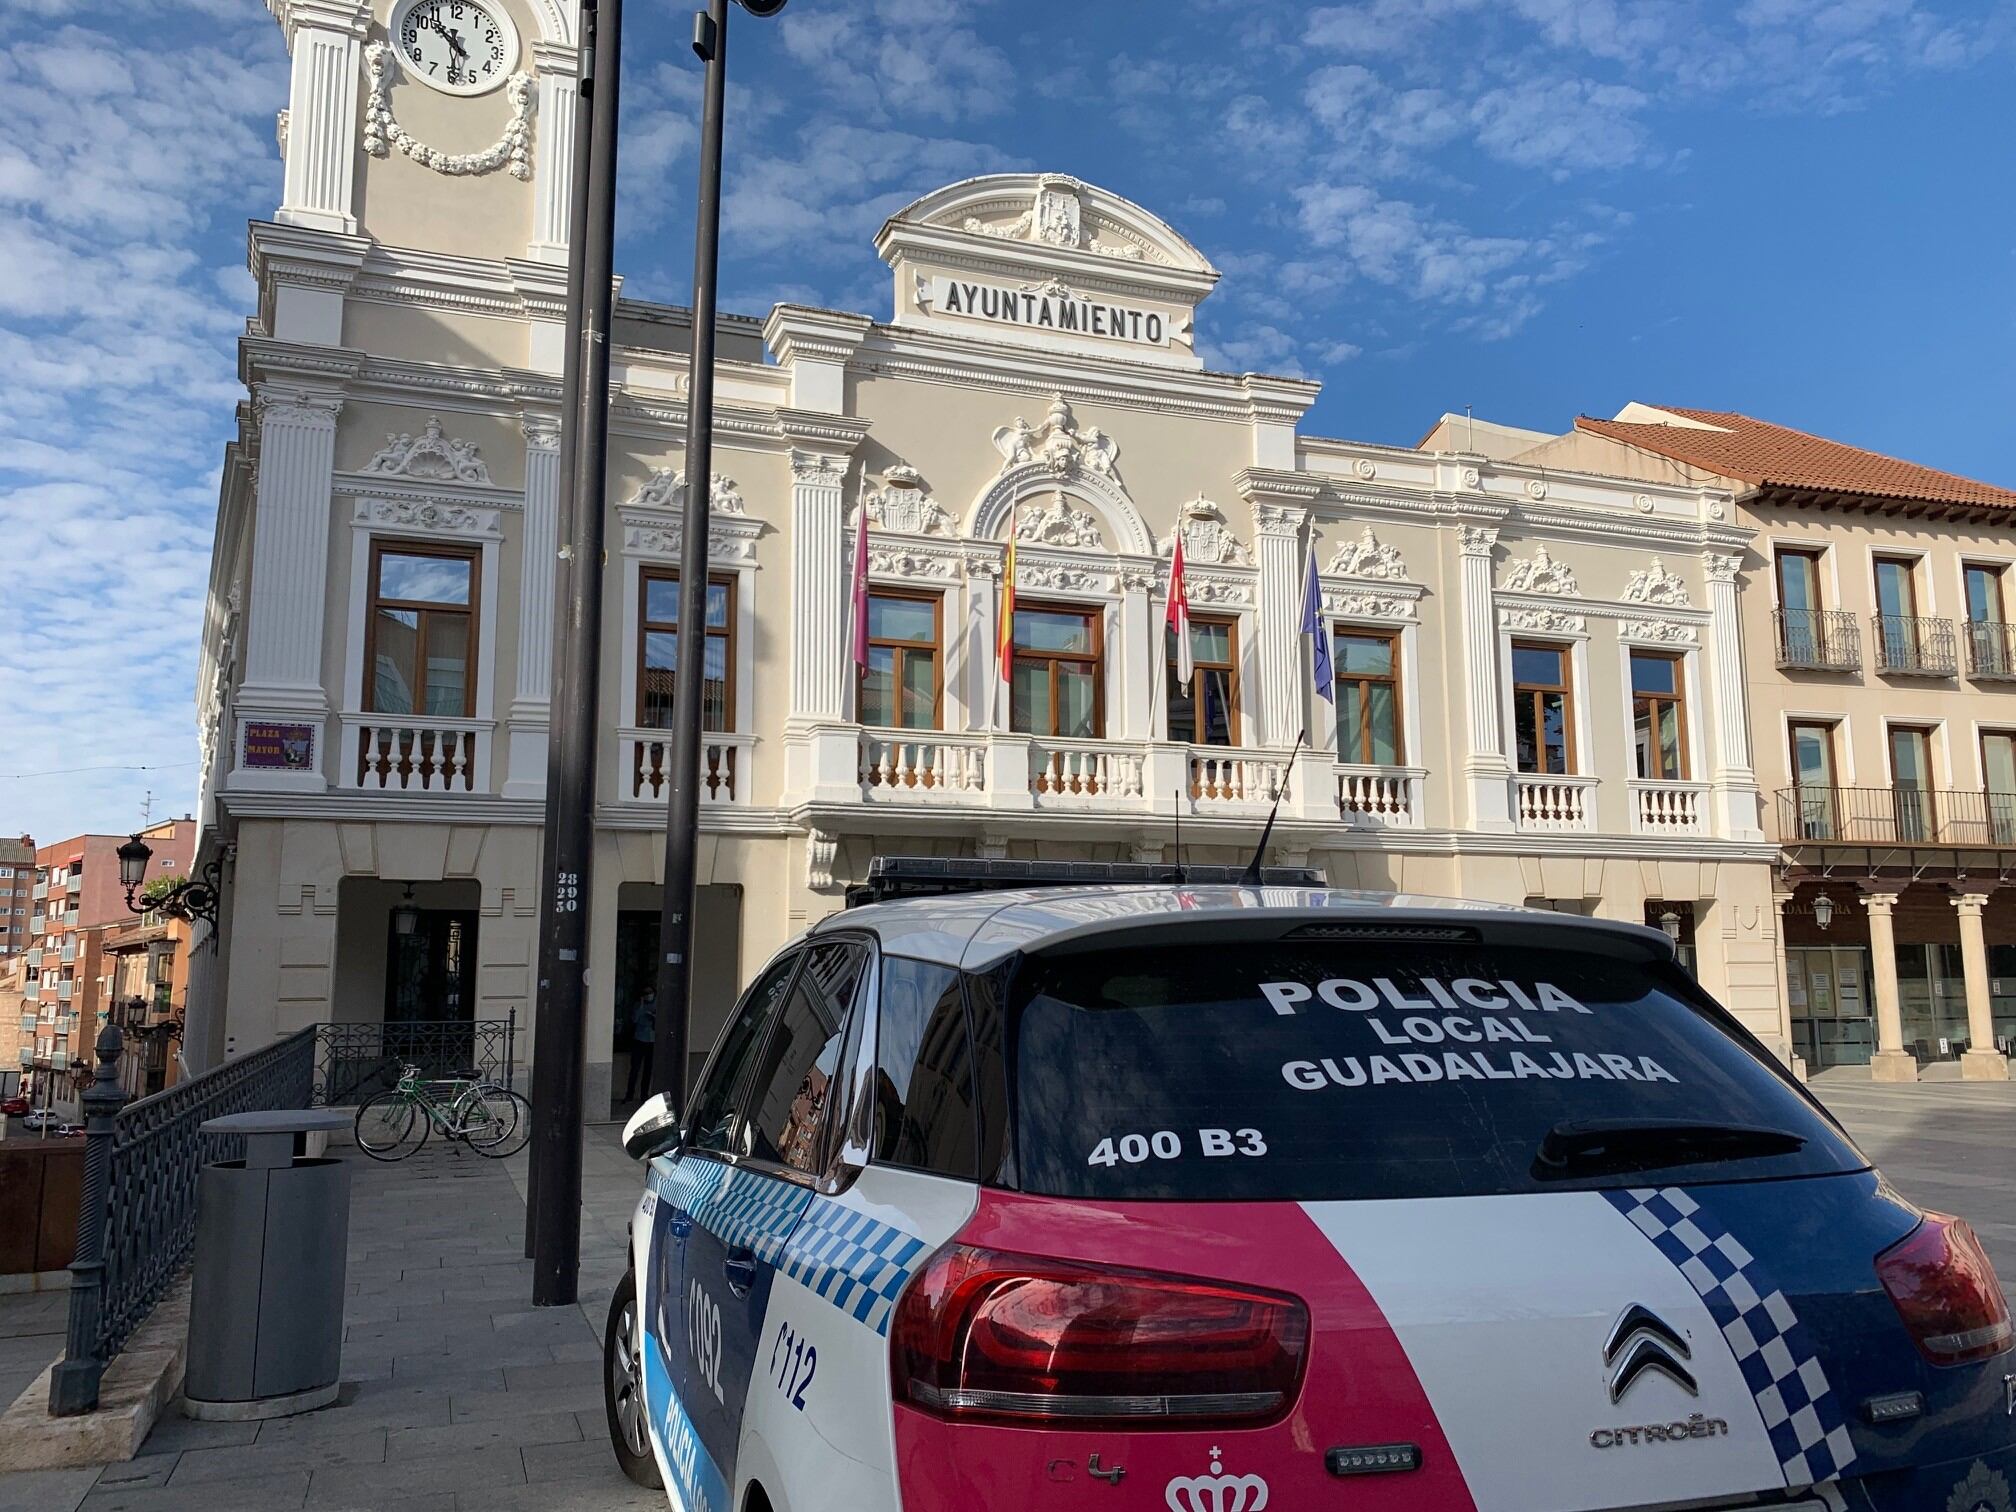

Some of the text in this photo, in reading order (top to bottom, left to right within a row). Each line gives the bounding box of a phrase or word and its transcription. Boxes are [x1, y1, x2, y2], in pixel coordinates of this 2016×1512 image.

[430, 6, 440, 21] 11
[450, 5, 463, 20] 12
[416, 14, 429, 30] 10
[474, 15, 479, 29] 1
[408, 30, 417, 43] 9
[485, 30, 494, 43] 2
[413, 48, 422, 61] 8
[491, 47, 499, 60] 3
[429, 62, 438, 75] 7
[482, 60, 491, 74] 4
[469, 70, 477, 84] 5
[945, 281, 1162, 343] AYUNTAMIENTO
[249, 729, 280, 738] PLAZA
[247, 745, 280, 754] MAYOR
[558, 872, 577, 885] 28
[557, 886, 578, 899] 29
[1257, 977, 1595, 1015] POLICIA
[1366, 1016, 1553, 1045] LOCAL
[1281, 1051, 1681, 1091] GUADALAJARA
[1087, 1128, 1268, 1167] 400 B3
[696, 1283, 724, 1406] 092
[778, 1329, 817, 1412] 112
[664, 1391, 697, 1492] POLICIA
